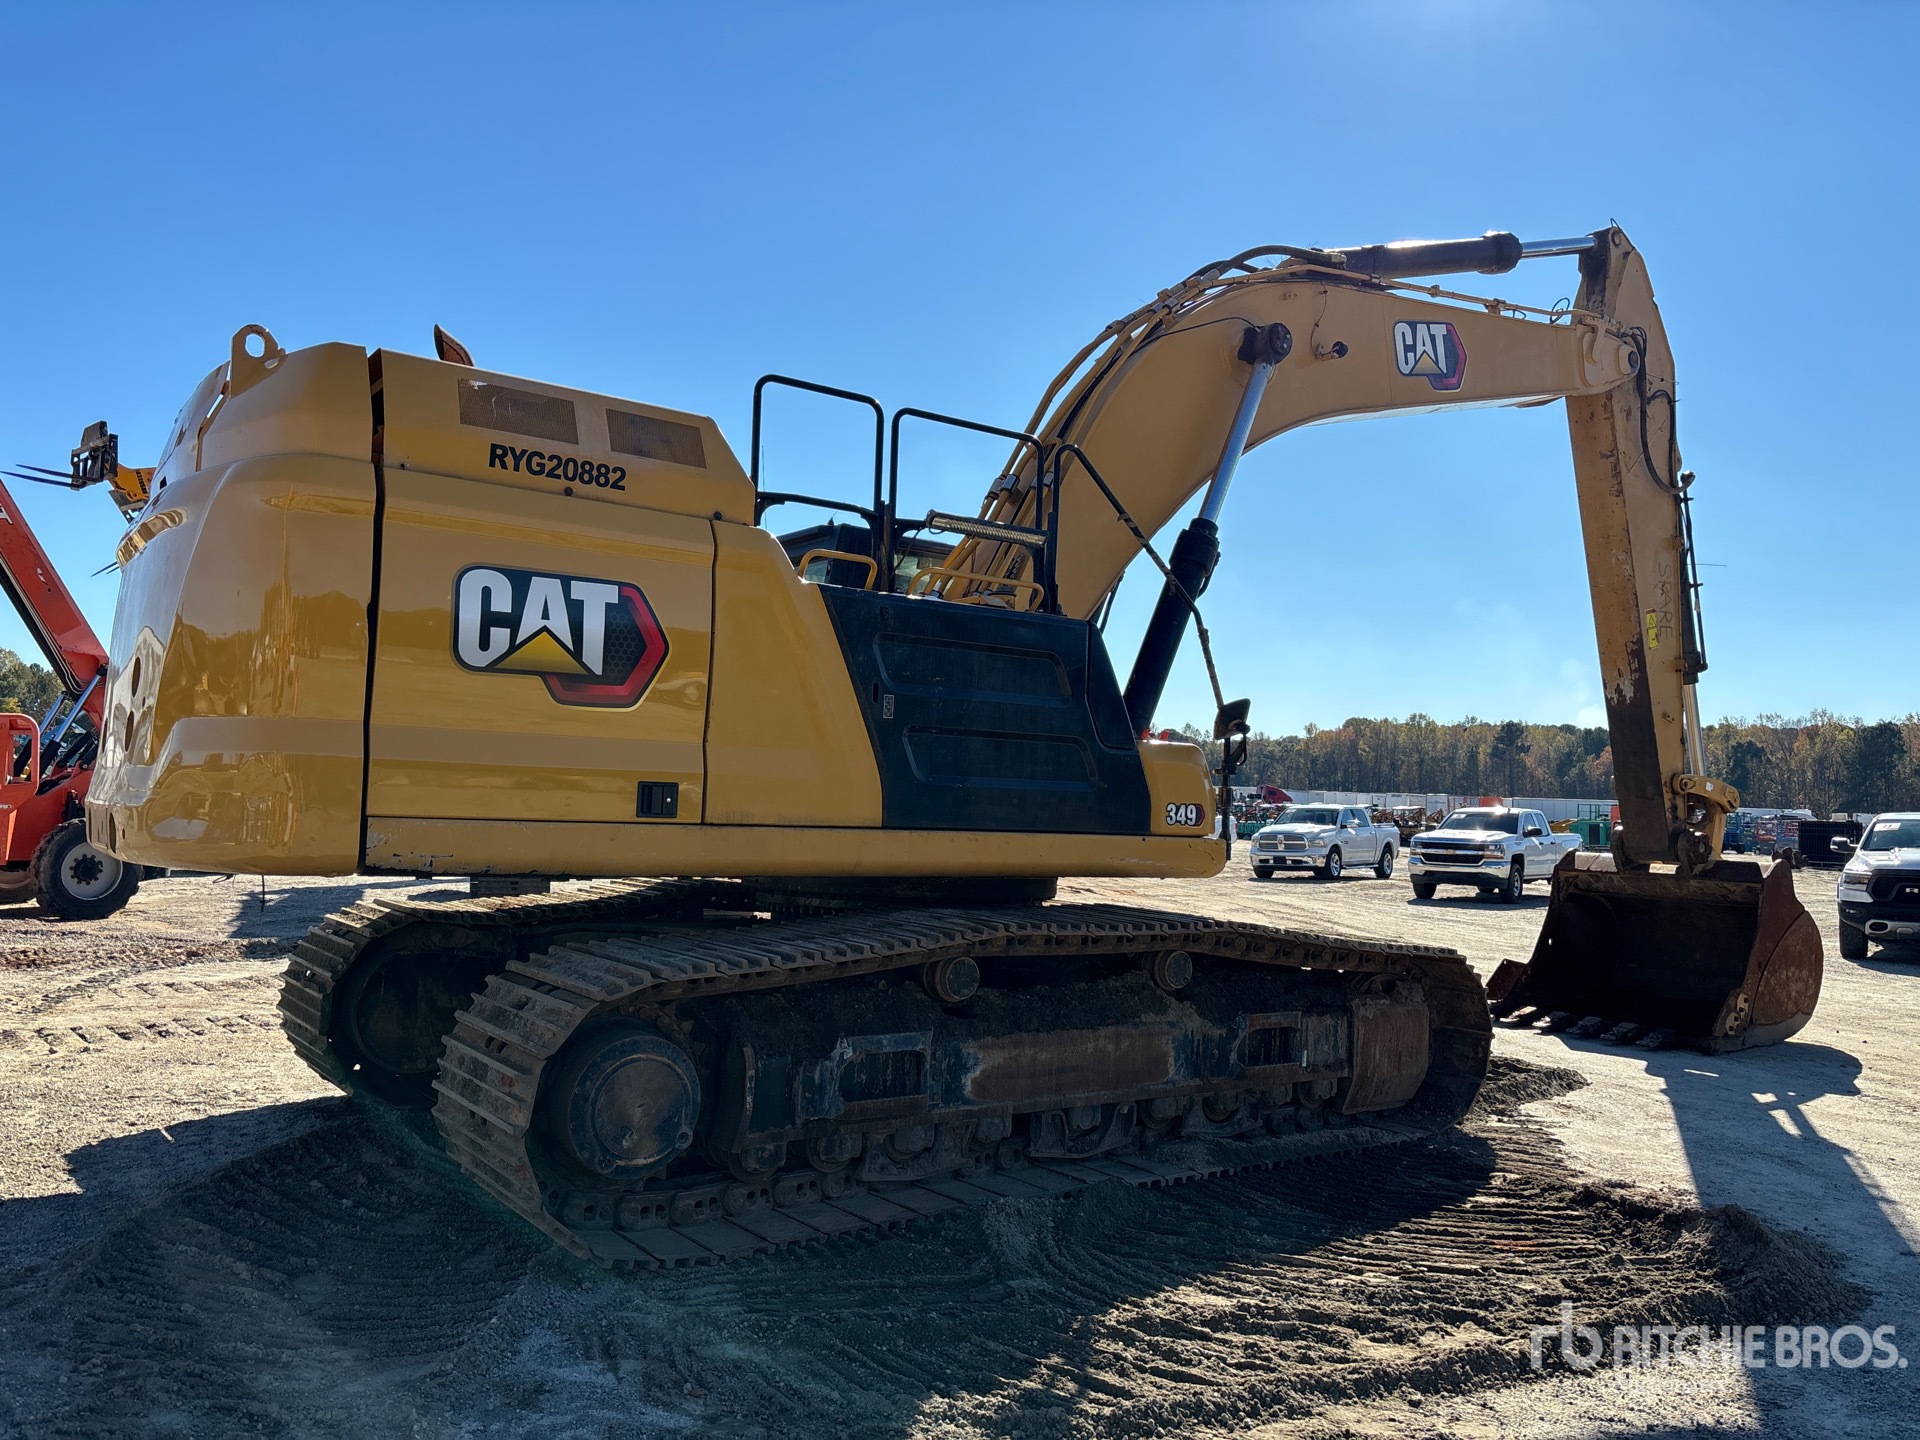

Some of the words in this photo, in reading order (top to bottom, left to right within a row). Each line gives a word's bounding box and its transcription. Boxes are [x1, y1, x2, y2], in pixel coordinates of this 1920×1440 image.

[1394, 322, 1447, 374] CAT
[488, 442, 627, 491] RYG20882
[458, 568, 619, 676] CAT
[1166, 803, 1197, 826] 349
